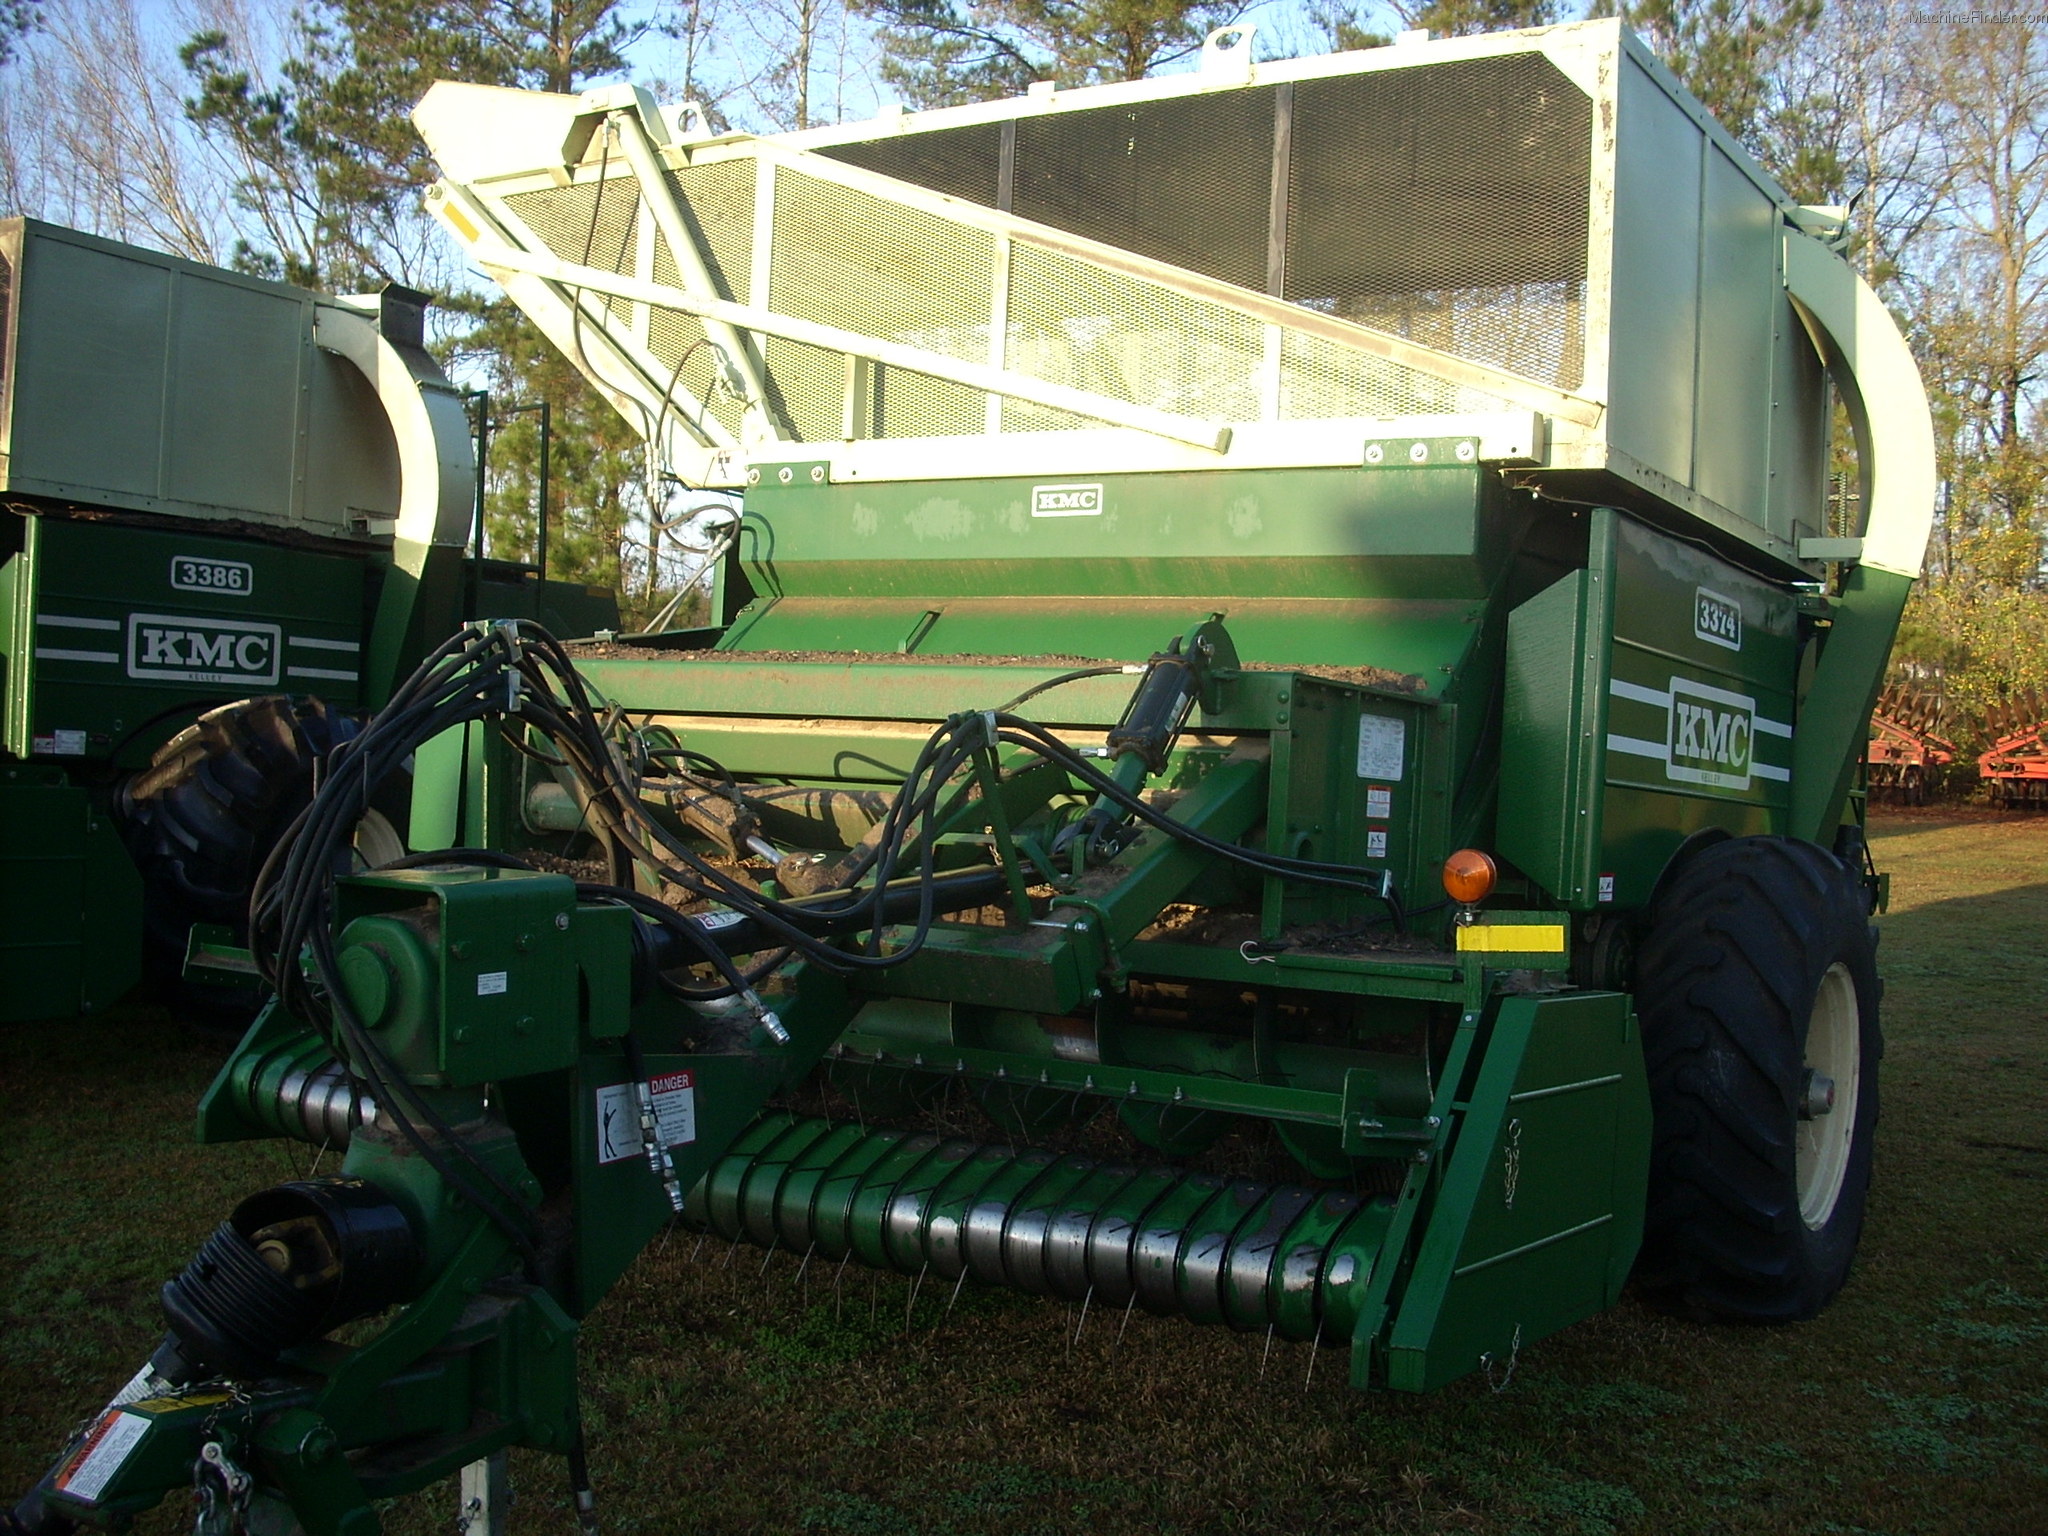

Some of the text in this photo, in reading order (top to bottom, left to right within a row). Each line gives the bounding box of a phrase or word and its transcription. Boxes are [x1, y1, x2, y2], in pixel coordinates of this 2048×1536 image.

[1038, 491, 1097, 509] KMC
[182, 563, 242, 589] 3386
[1700, 599, 1736, 638] 3374
[142, 628, 269, 670] KMC
[188, 673, 223, 682] KELLEY
[1675, 702, 1749, 767] KMC
[651, 1074, 689, 1094] DANGER
